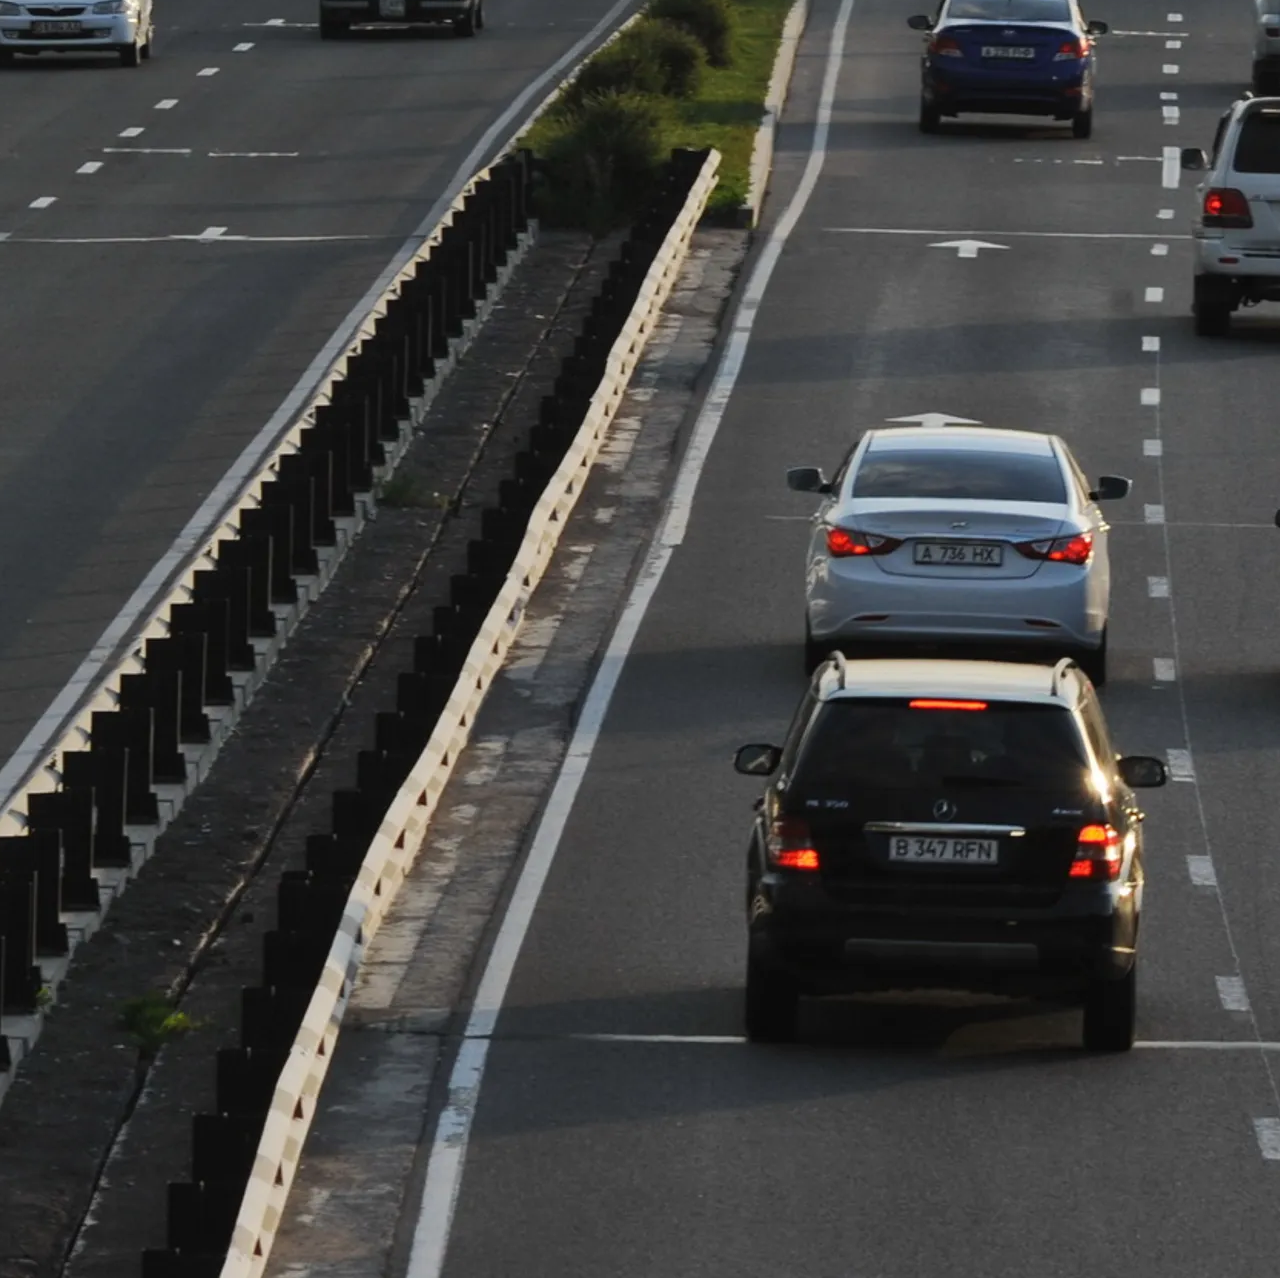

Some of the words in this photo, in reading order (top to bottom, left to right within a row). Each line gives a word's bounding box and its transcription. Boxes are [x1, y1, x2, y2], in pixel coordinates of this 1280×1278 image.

[922, 548, 932, 561] A
[940, 547, 965, 561] 736
[895, 838, 908, 857] B
[916, 839, 948, 858] 347
[953, 840, 993, 860] RFN
